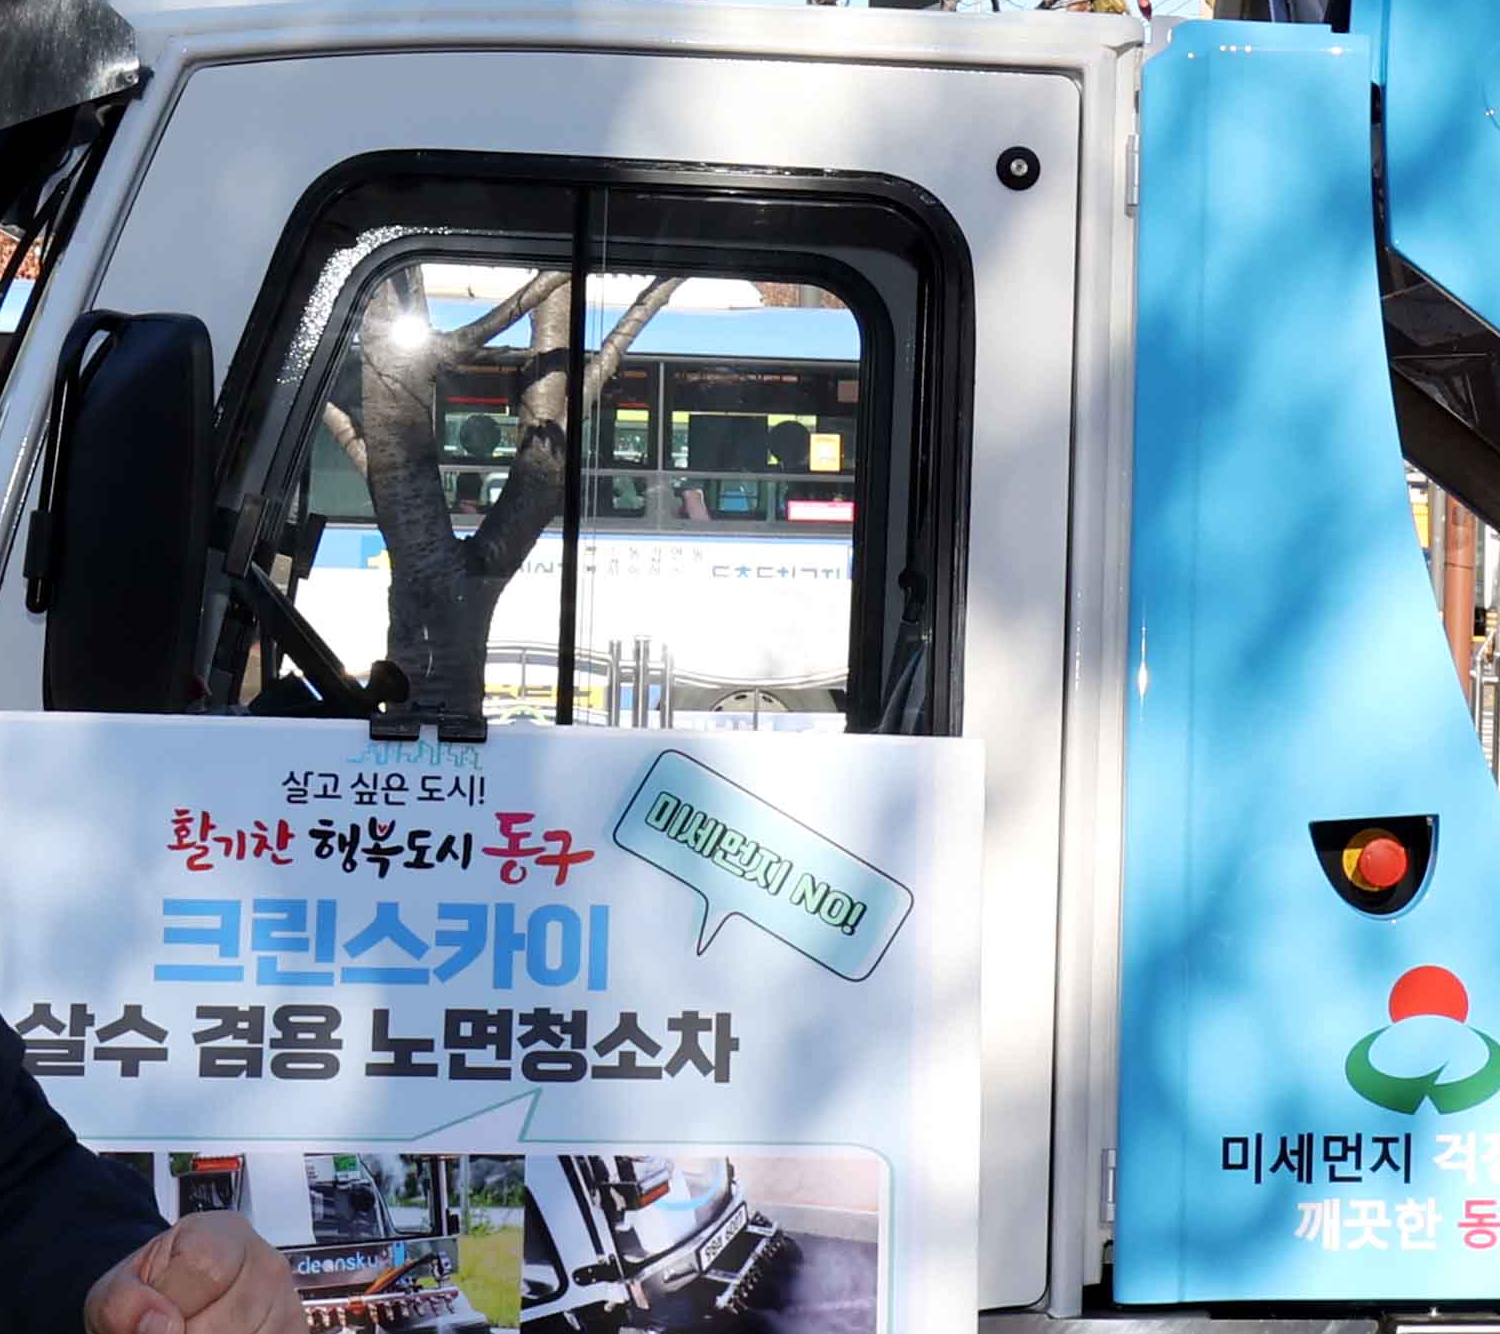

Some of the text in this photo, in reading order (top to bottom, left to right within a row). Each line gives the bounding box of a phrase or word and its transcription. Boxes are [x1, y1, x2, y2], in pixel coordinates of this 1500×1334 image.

[283, 771, 485, 806] 살고 싶은 도시!
[167, 808, 594, 886] 활기찬 행복도시 동구
[645, 791, 866, 936] 미세먼지 NO!
[154, 898, 609, 991] 크린스카이
[14, 1003, 740, 1083] 살수 겸용 노면청소차
[1221, 1133, 1412, 1183] 미세먼지
[1295, 1199, 1443, 1250] 깨끗한
